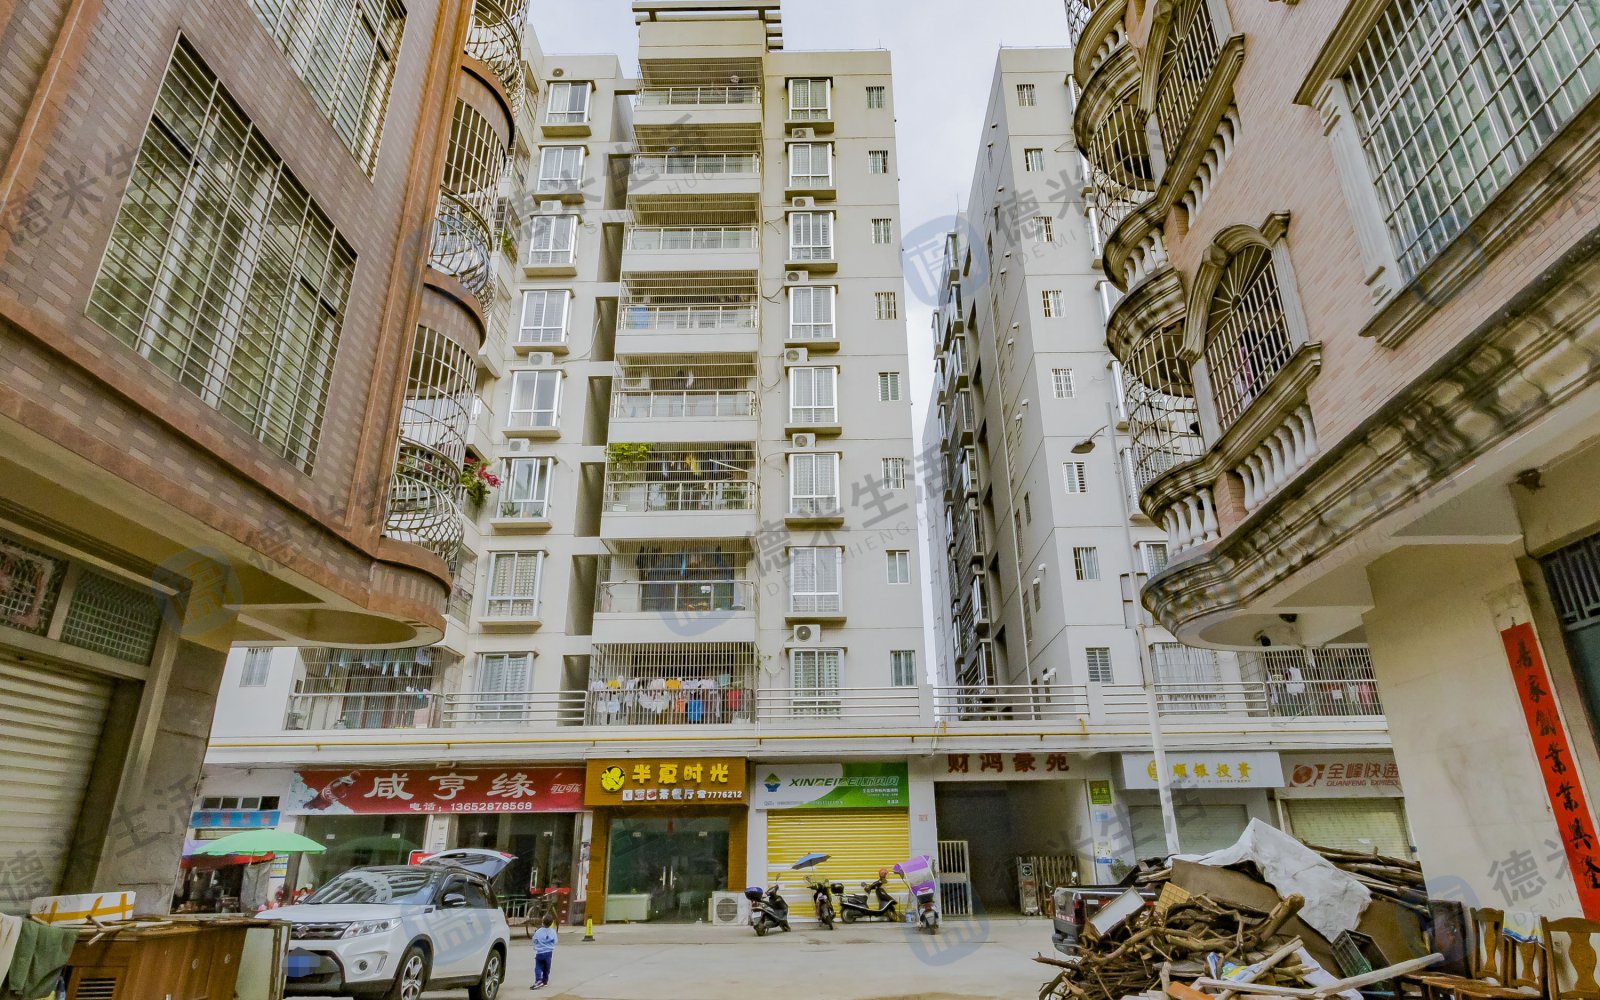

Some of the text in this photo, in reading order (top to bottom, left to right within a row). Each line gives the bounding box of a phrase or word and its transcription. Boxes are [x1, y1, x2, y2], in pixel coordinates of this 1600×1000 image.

[631, 763, 729, 784] 半夏时光
[1327, 763, 1400, 778] 全峰快递
[363, 772, 537, 800] 咸亨缘
[707, 790, 743, 799] 7776212
[450, 802, 533, 812] 13652878568
